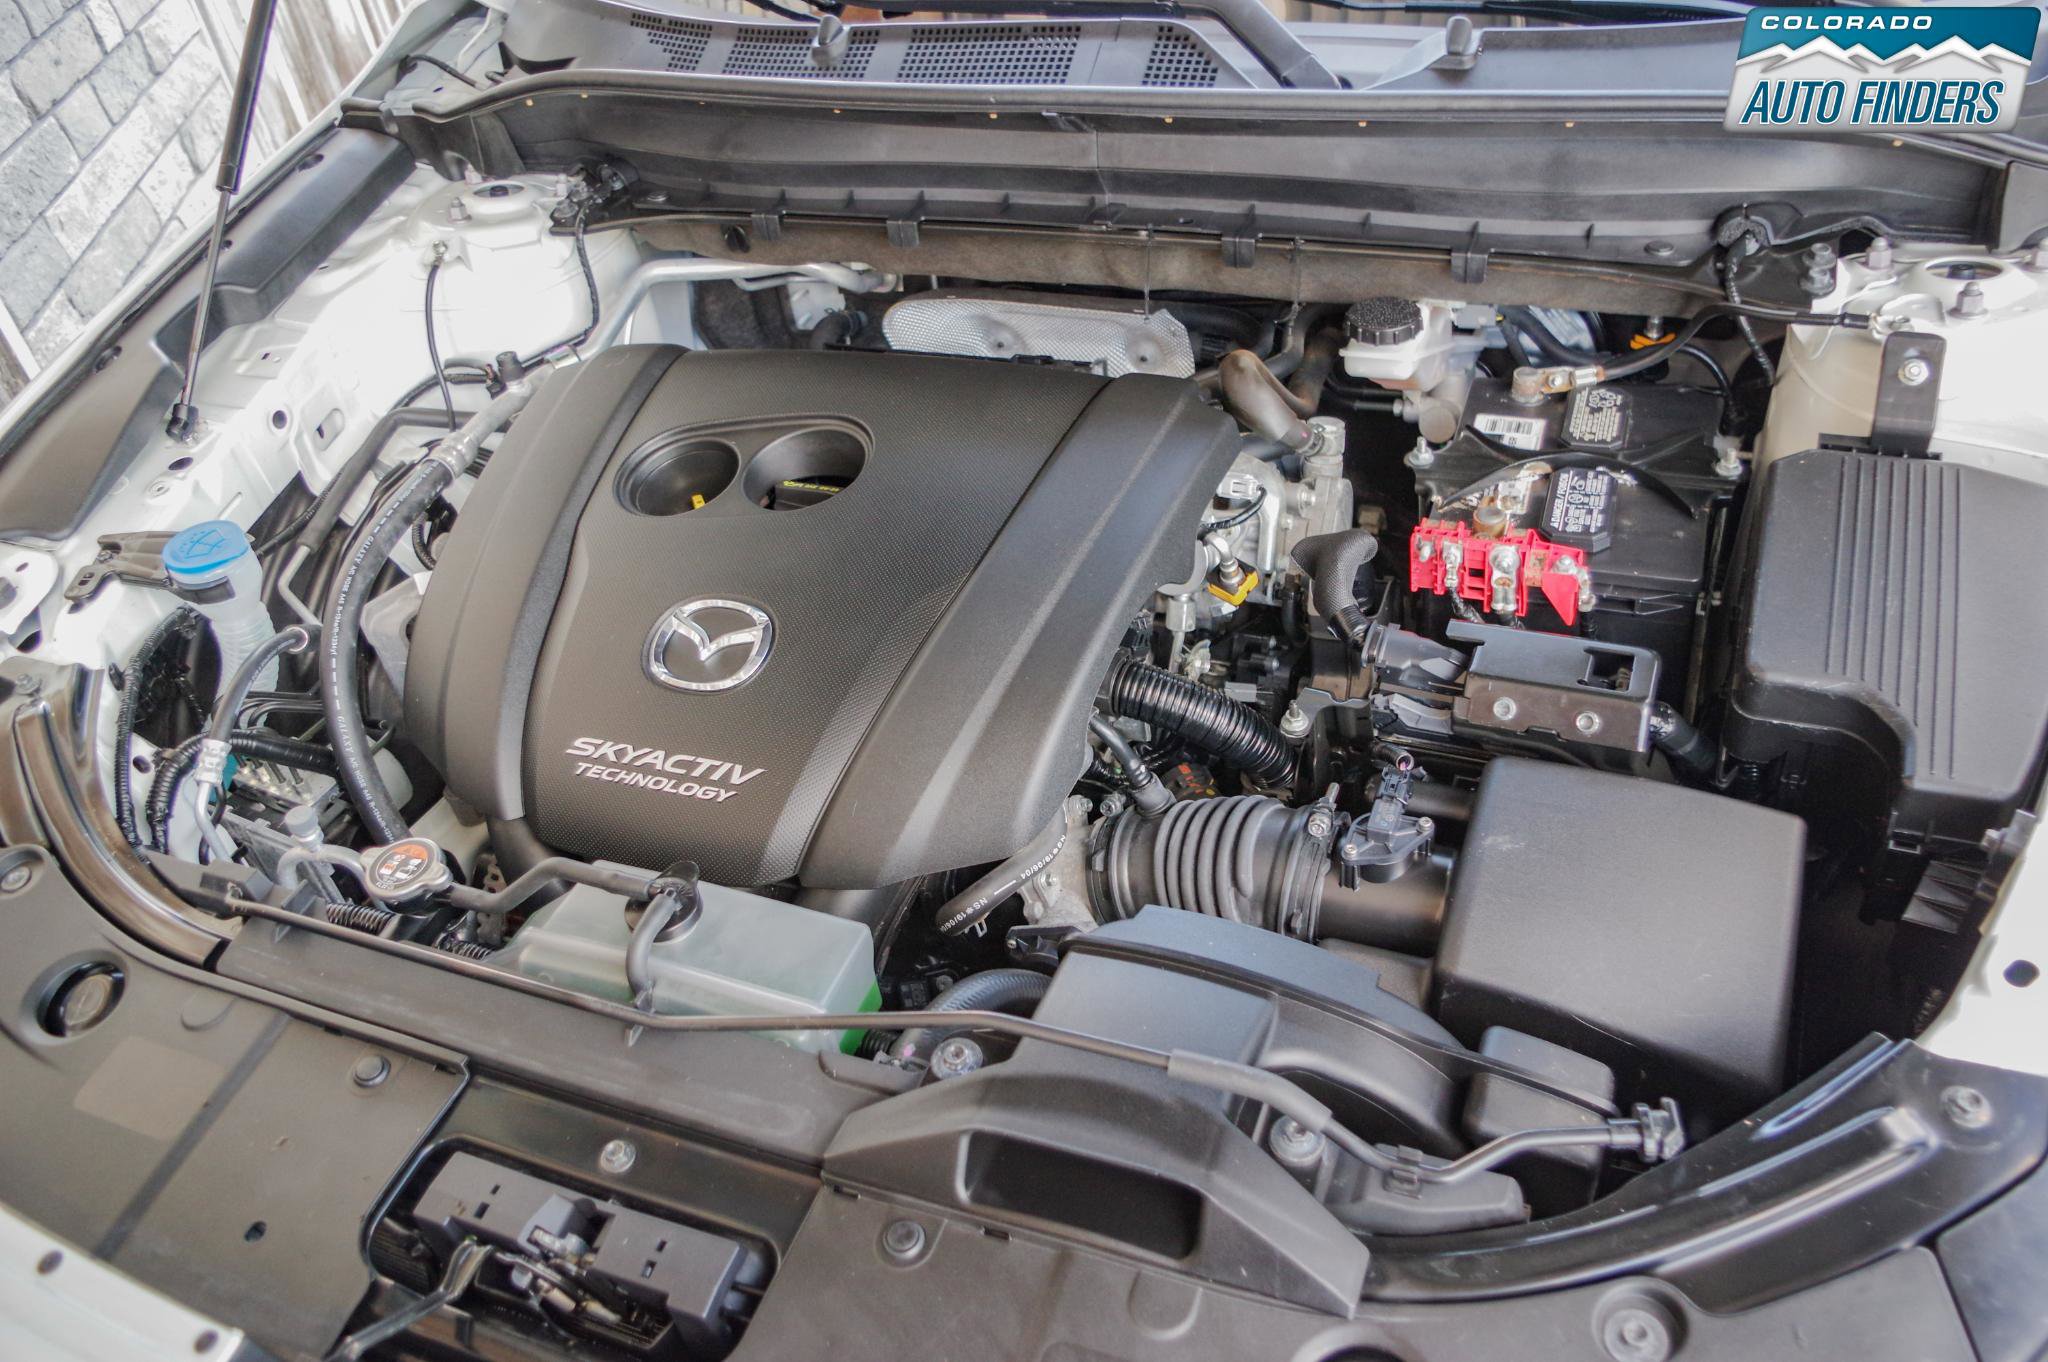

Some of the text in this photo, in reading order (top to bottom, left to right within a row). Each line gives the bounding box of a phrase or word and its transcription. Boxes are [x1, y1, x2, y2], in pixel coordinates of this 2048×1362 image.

[355, 535, 374, 564] GALAXY
[337, 715, 354, 753] GALAXY
[566, 737, 768, 785] SKYACTIV
[575, 762, 737, 802] TECHNOLOGY
